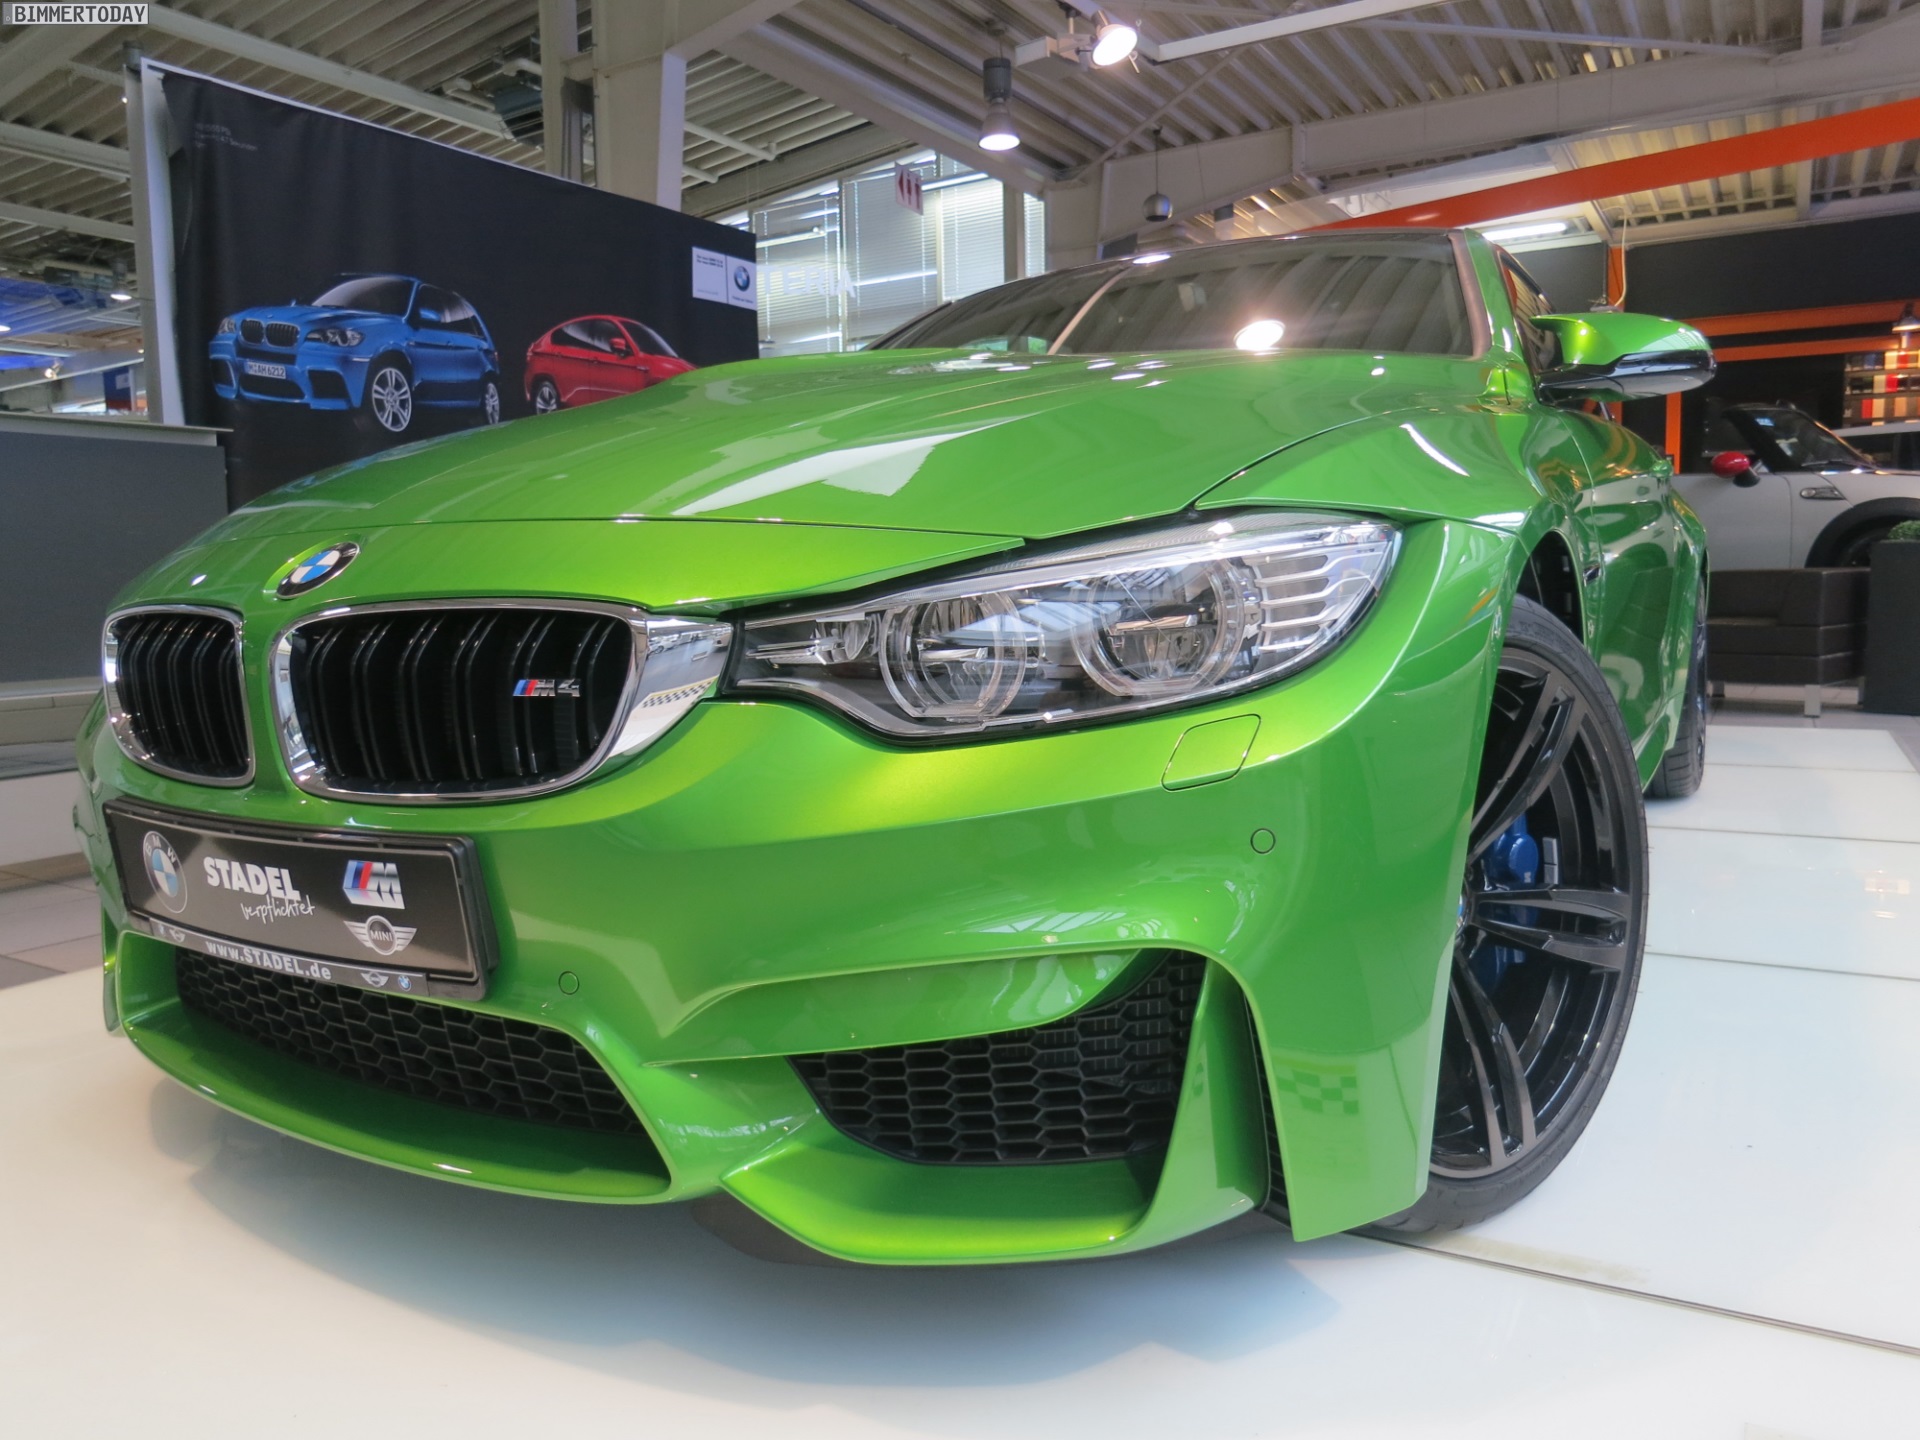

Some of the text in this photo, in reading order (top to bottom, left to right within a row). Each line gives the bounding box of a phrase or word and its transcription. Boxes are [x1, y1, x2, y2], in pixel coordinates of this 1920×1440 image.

[203, 856, 301, 901] STADEL
[240, 894, 316, 925] verpflichtet
[370, 929, 393, 942] MINI
[205, 941, 332, 980] www.STADEL.de
